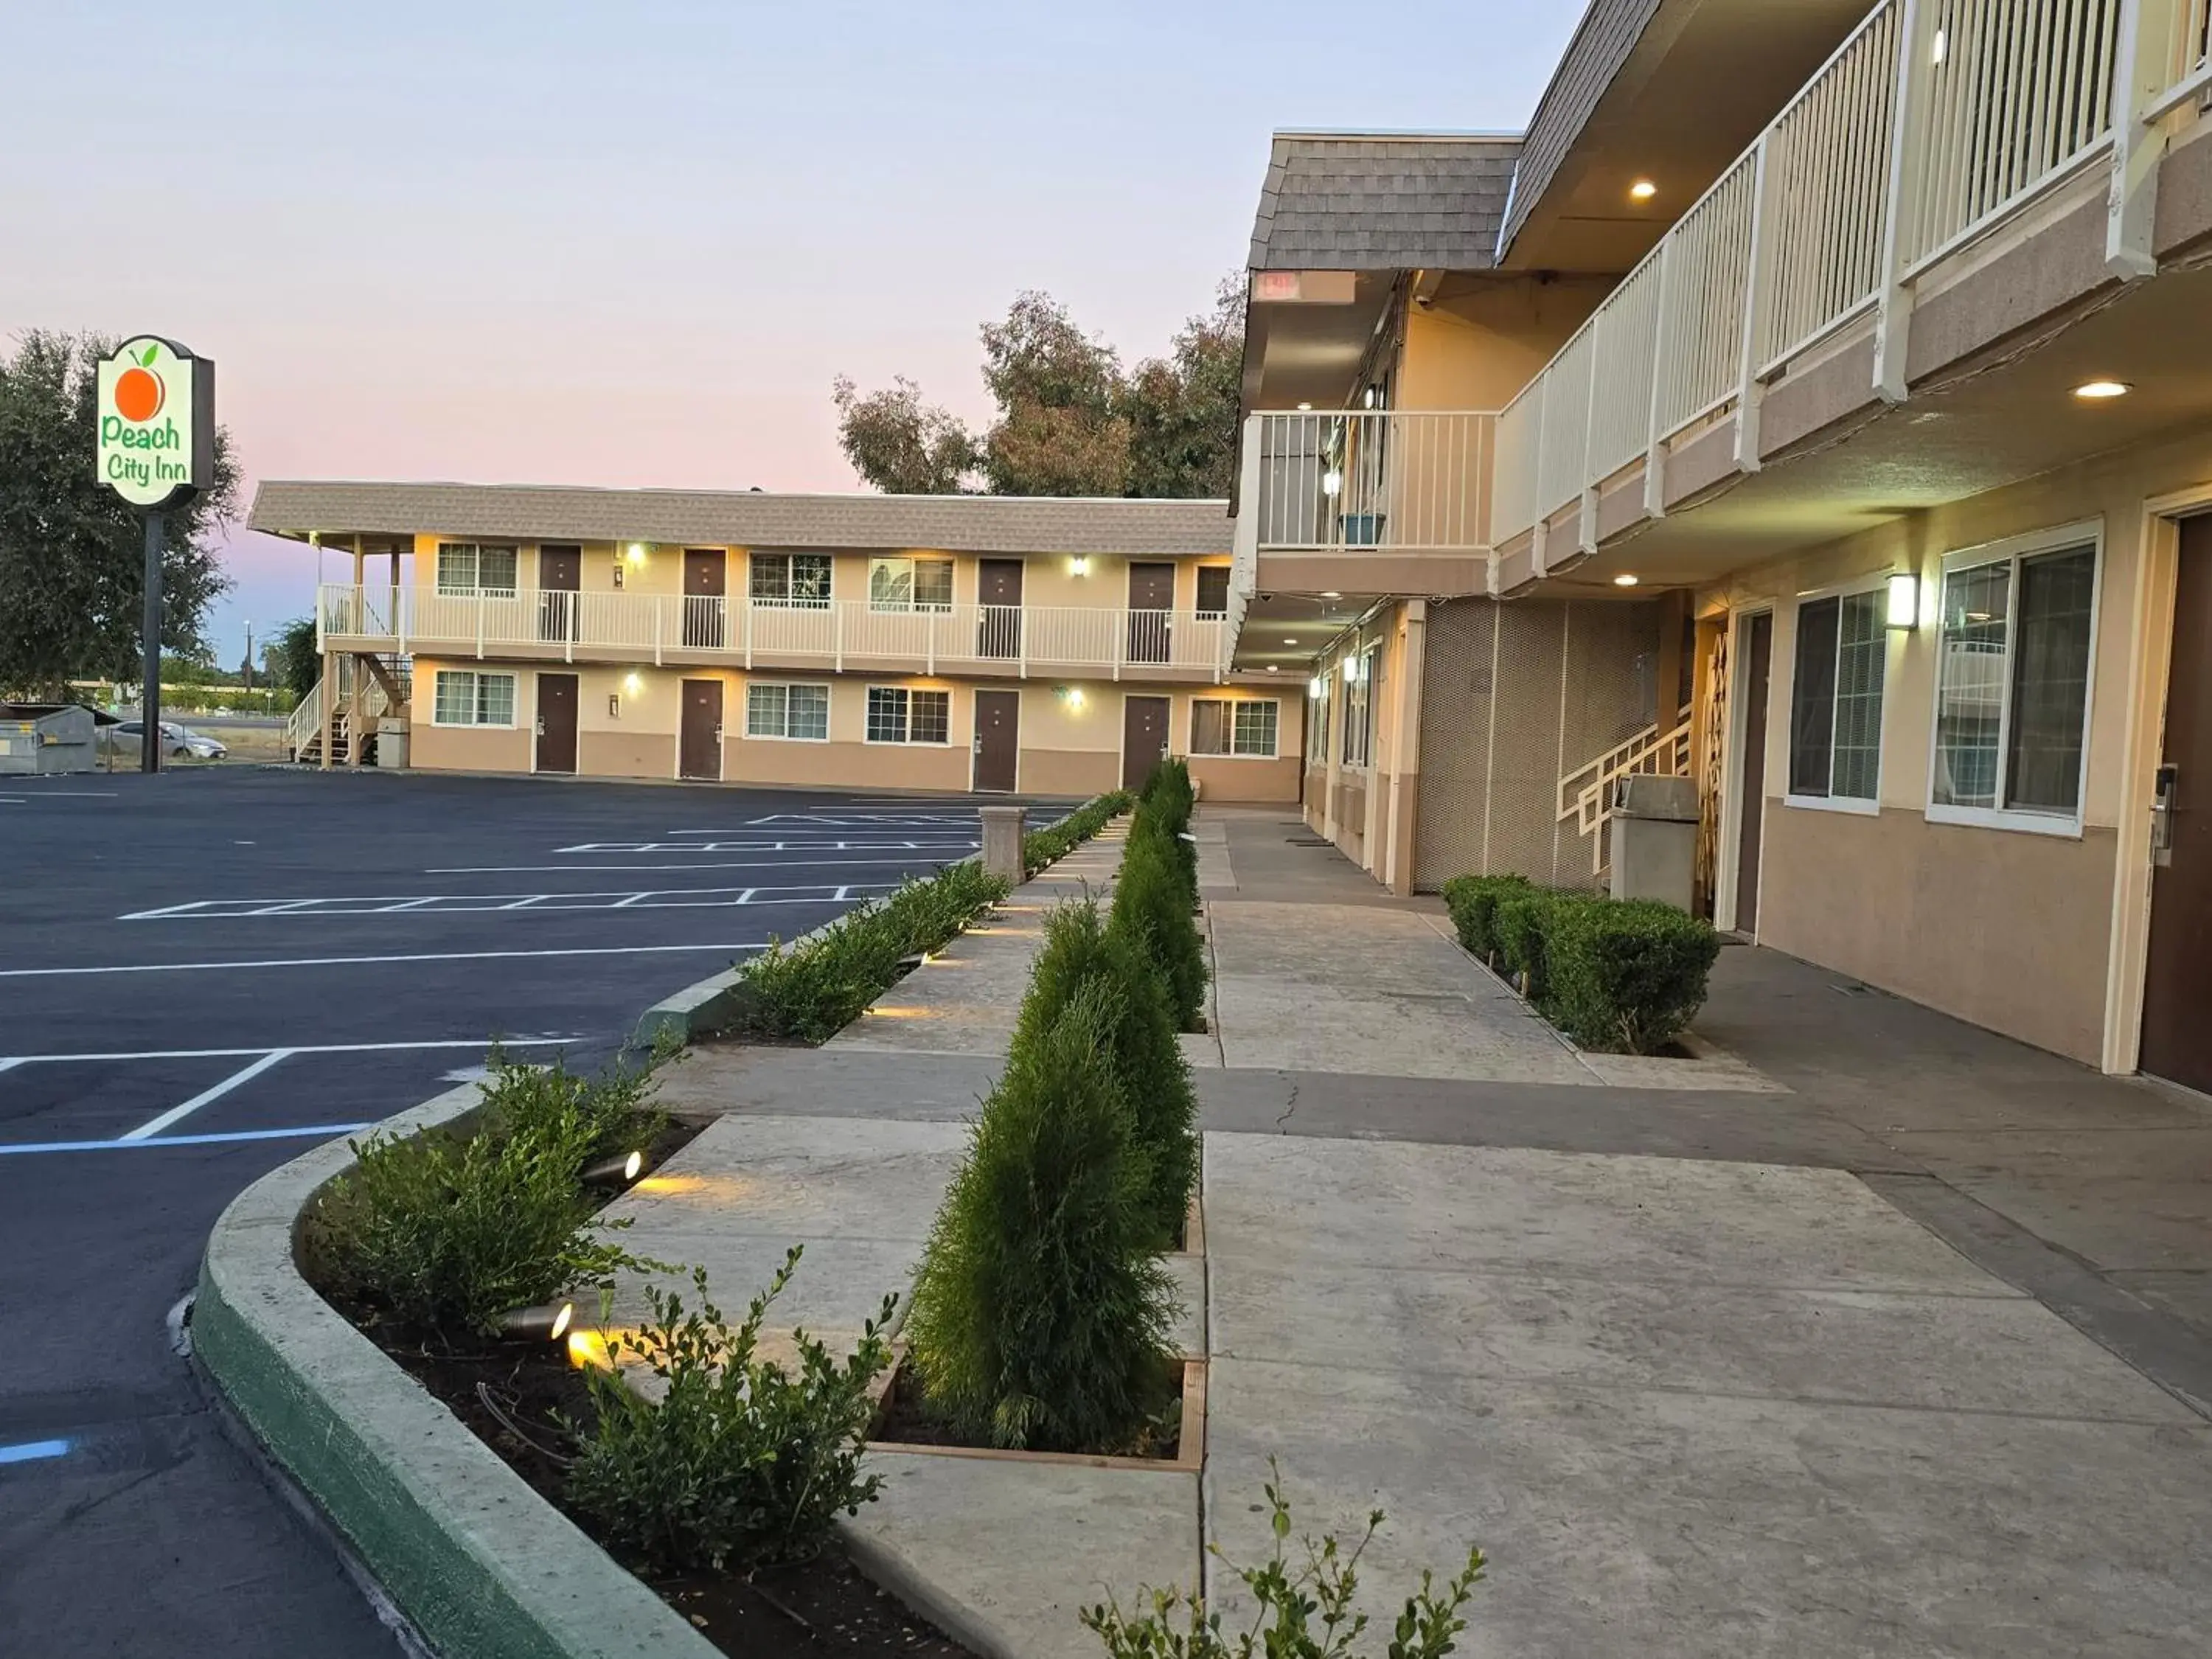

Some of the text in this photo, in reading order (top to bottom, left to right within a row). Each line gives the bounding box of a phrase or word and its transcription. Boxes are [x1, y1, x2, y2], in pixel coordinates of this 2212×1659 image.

[102, 416, 179, 450] Peach
[108, 453, 187, 487] City Inn
